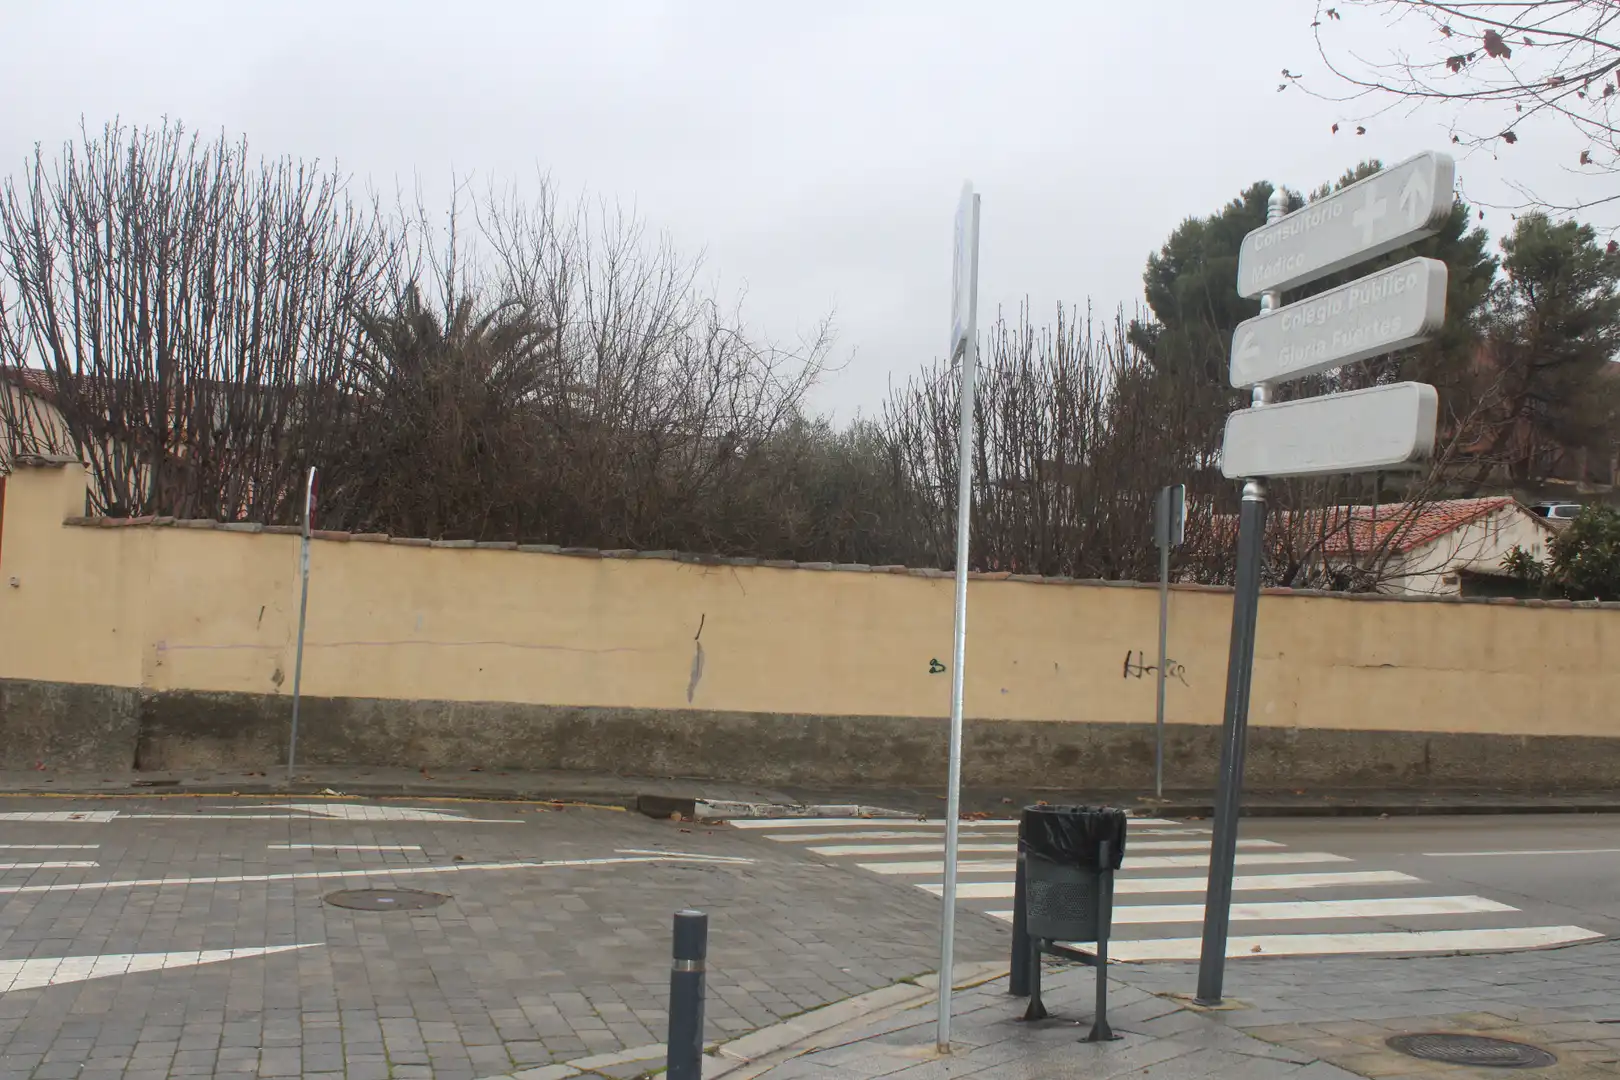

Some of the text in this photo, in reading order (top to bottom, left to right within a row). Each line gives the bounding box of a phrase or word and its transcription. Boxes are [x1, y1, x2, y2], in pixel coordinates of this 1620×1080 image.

[1254, 201, 1343, 251] Consultorio
[1281, 272, 1417, 331] Colegio Público
[1278, 315, 1402, 366] Gloria Fuertes
